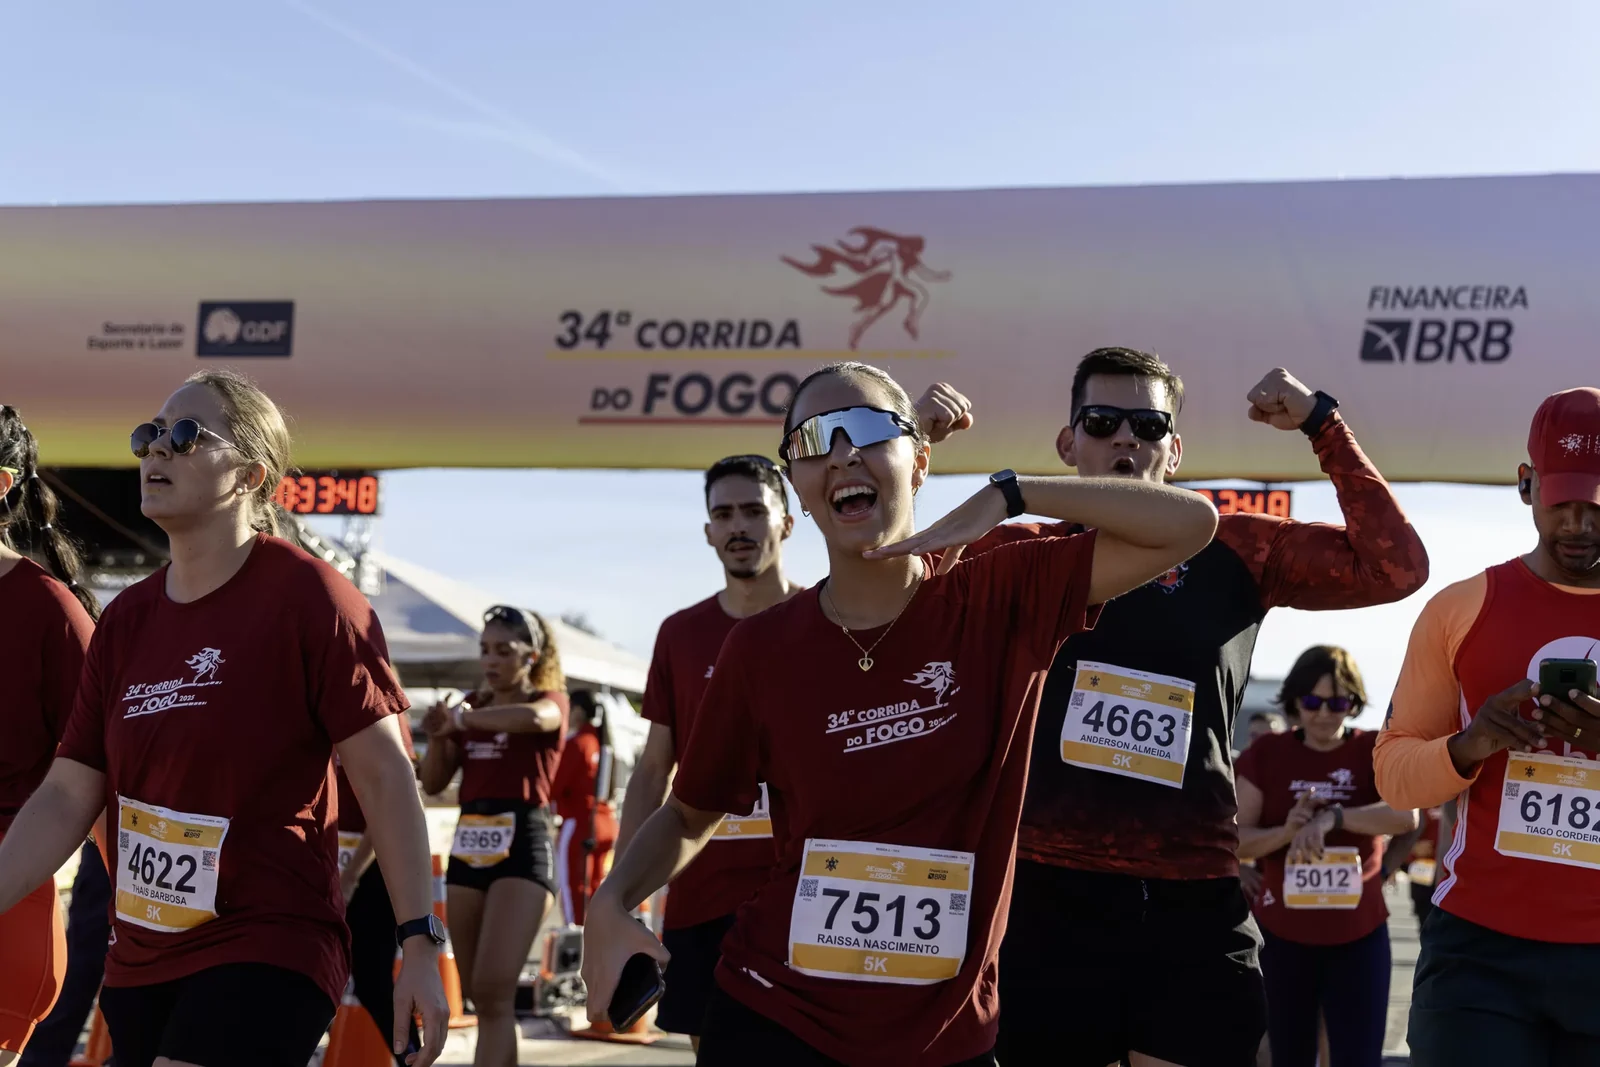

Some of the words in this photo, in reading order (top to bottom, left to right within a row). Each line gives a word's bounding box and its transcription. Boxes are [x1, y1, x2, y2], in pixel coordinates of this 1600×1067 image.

[1367, 285, 1529, 310] FINANCEIRA
[635, 319, 802, 349] CORRIDA
[1414, 318, 1514, 363] BRB
[590, 387, 632, 411] DO
[642, 372, 800, 415] FOGO
[145, 677, 183, 694] CORRIDA
[127, 705, 139, 714] DO
[139, 692, 178, 712] FOGO
[857, 699, 920, 722] CORRIDA
[846, 736, 862, 747] DO
[866, 717, 925, 744] FOGO
[1082, 700, 1176, 747] 4663
[1080, 734, 1130, 750] ANDERSON
[1131, 744, 1171, 759] ALMEIDA
[1112, 753, 1132, 768] 5K
[1525, 825, 1553, 836] TIAGO
[1556, 830, 1600, 843] CORDEIR
[1552, 843, 1573, 857] 5K
[128, 842, 197, 894] 4622
[1295, 868, 1349, 888] 5012
[132, 884, 149, 896] THAIS
[150, 890, 187, 905] BARBOSA
[146, 905, 161, 921] 5K
[822, 887, 941, 940] 7513
[817, 934, 861, 948] RAISSA
[863, 939, 940, 955] NASCIMENTO
[864, 956, 889, 973] 5K
